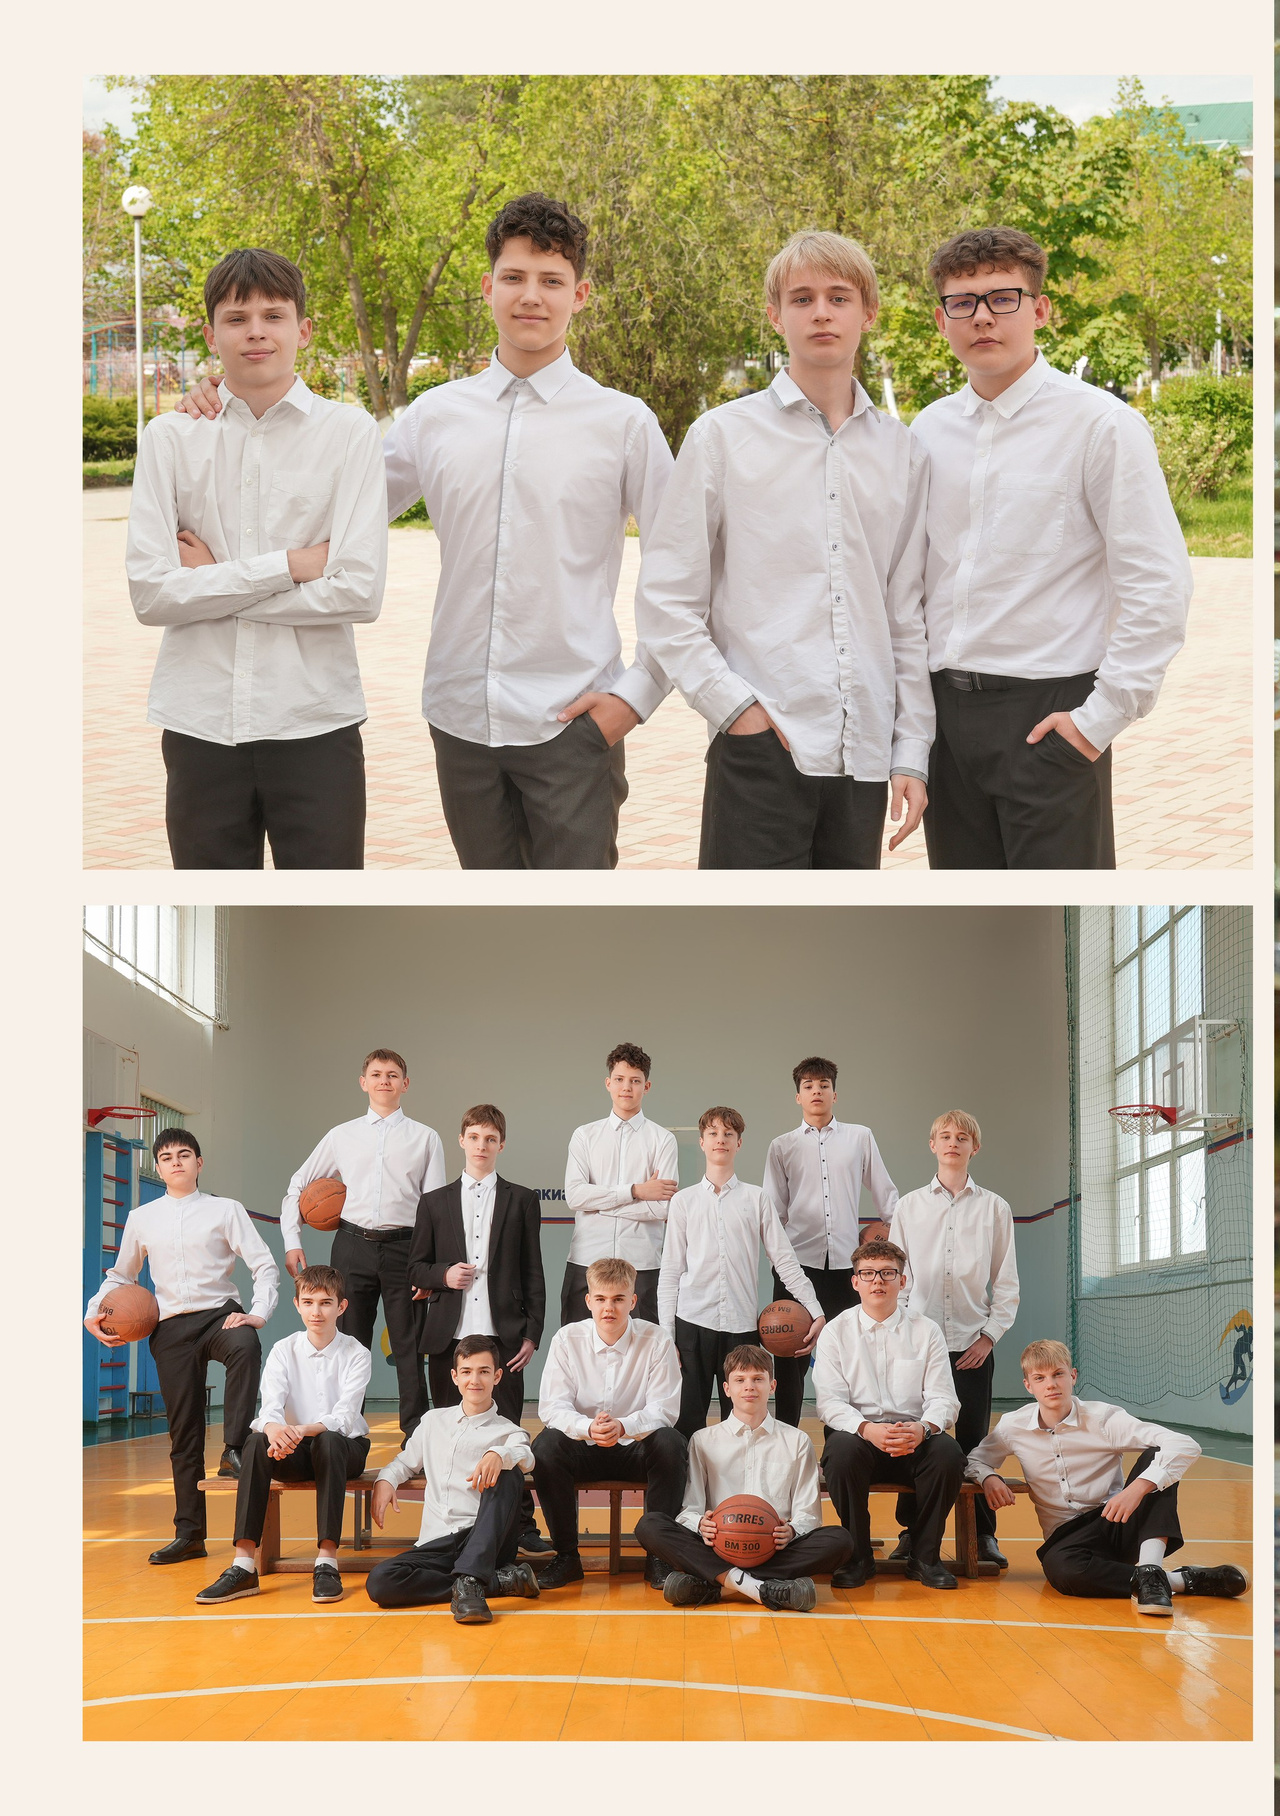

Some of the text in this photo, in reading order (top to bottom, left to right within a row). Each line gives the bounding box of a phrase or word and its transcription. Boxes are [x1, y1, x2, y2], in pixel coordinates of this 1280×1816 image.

[761, 1324, 795, 1334] TORRES
[722, 1513, 765, 1526] TORRES
[724, 1540, 739, 1550] BM
[742, 1542, 760, 1551] 300
